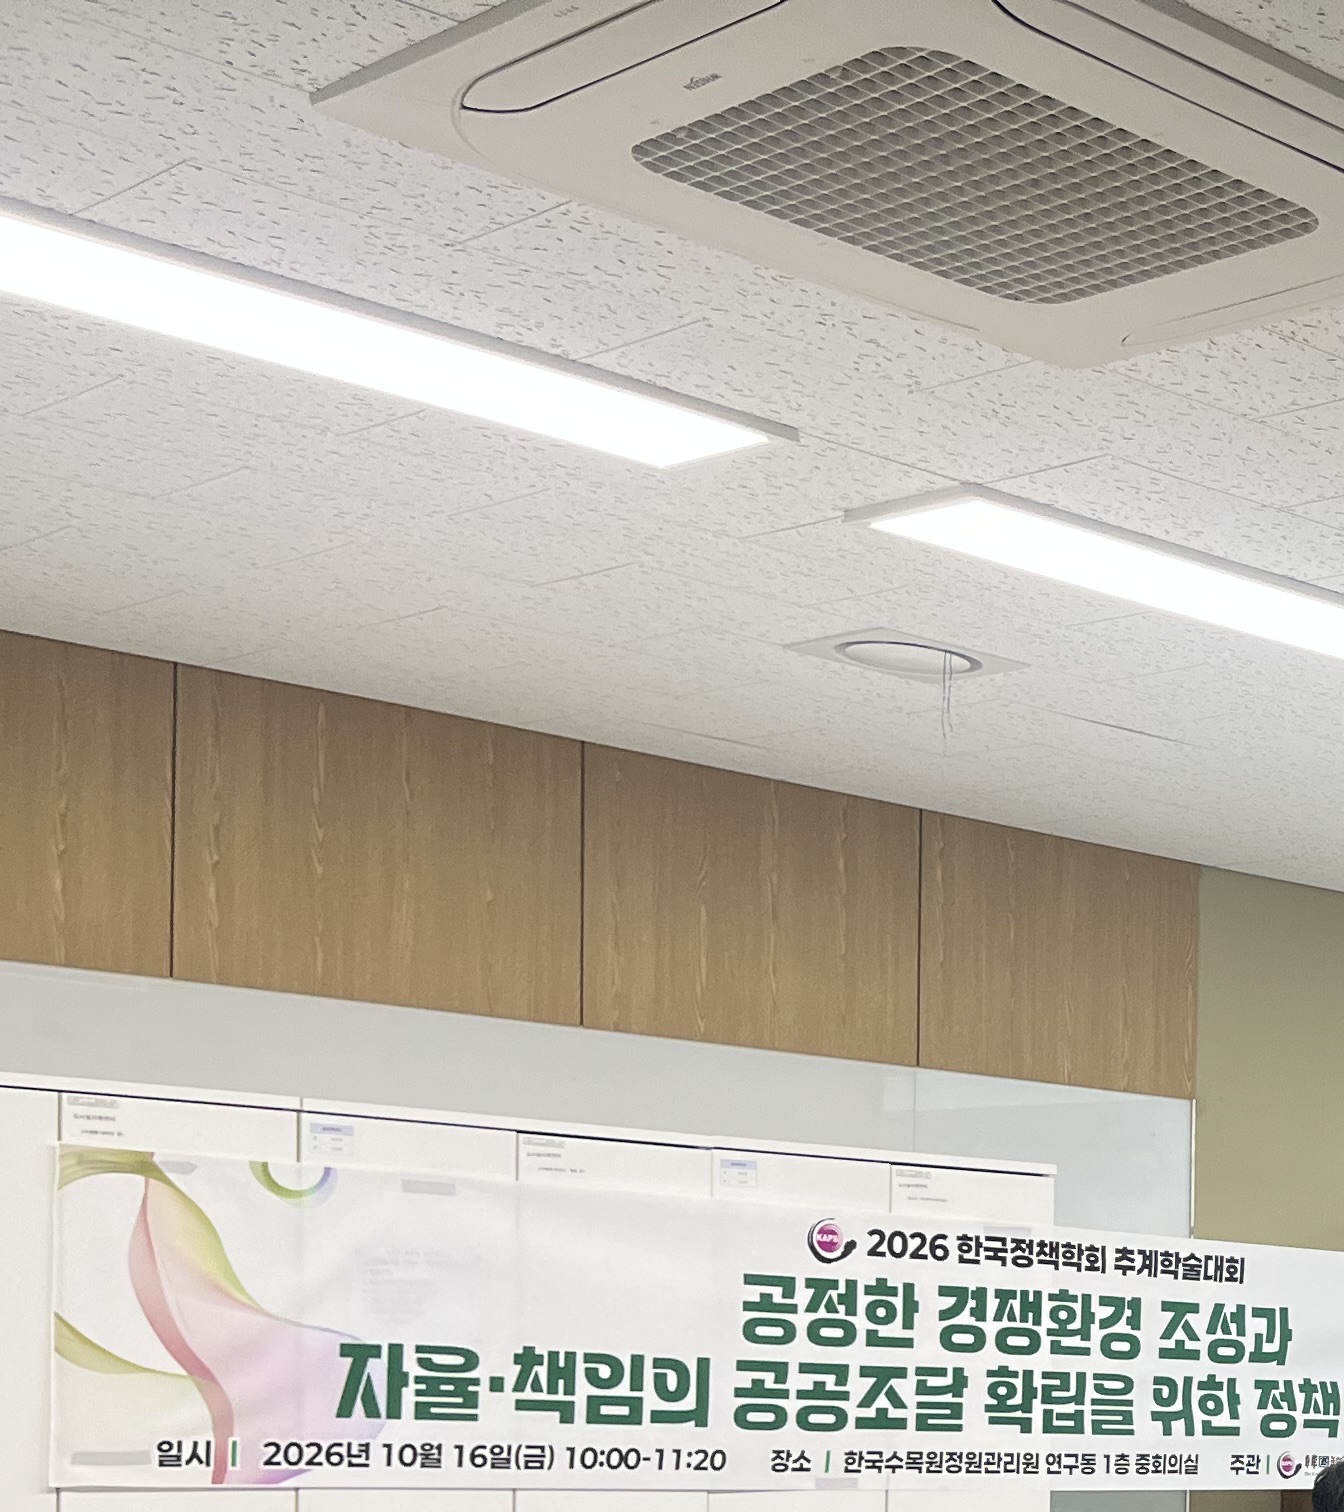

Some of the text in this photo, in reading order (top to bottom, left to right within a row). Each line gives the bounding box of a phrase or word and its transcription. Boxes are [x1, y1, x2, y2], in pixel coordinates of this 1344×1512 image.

[867, 1229, 1245, 1284] 2026 한국정책학회 추계학술대회
[742, 1273, 1292, 1366] 공정한 경쟁환경 조성과
[734, 1360, 968, 1432] 공공조달
[984, 1365, 1135, 1435] 확립을
[1151, 1374, 1241, 1436] 위한
[1254, 1378, 1340, 1438] 정책
[157, 1440, 726, 1471] 일시 2026년 10월 16일(금) 10:00-11:20
[771, 1450, 1198, 1475] 장소 한국수목원정원관리원 연구동 1층 중회의실
[1230, 1455, 1261, 1475] 주관
